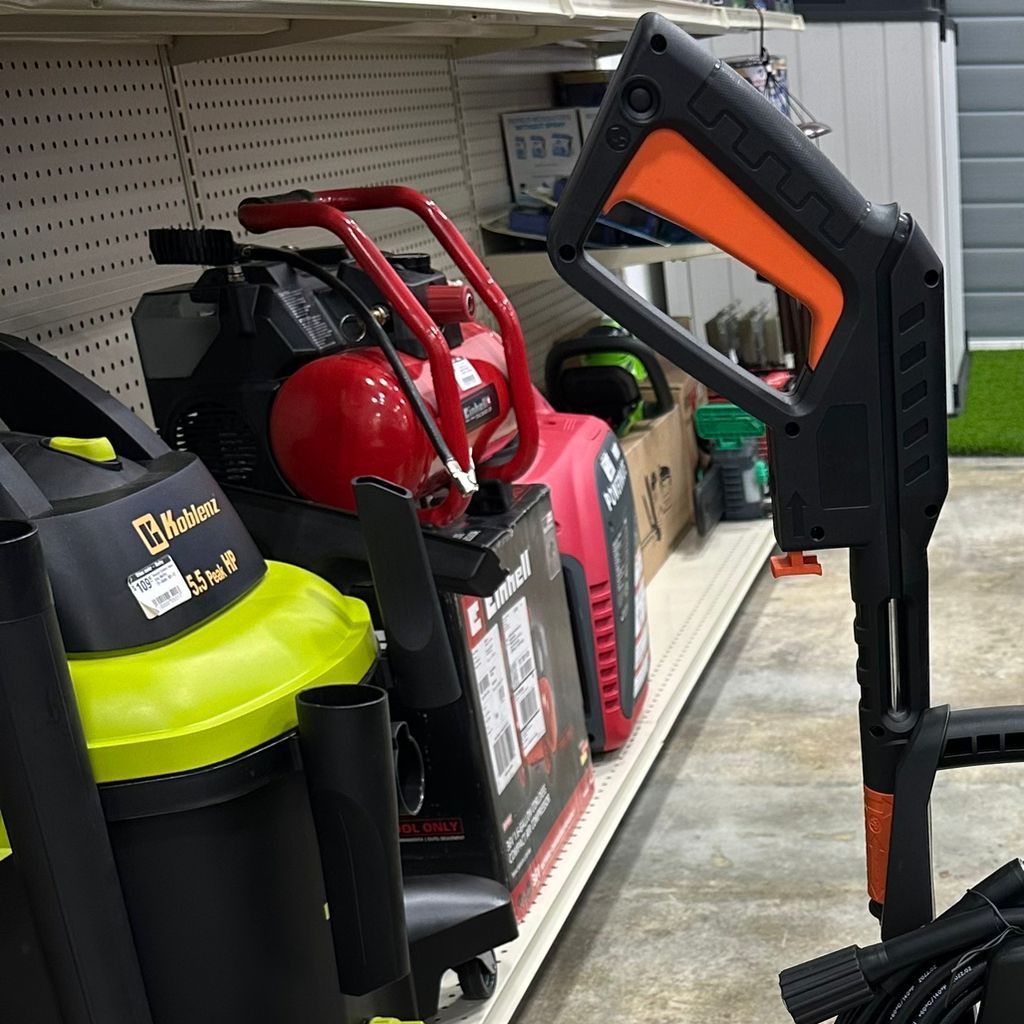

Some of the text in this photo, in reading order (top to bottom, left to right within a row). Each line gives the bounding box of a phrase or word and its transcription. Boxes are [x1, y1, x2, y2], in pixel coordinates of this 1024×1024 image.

[160, 498, 220, 540] Koblenz
[185, 569, 208, 596] 5.5
[204, 563, 228, 586] Peak
[220, 549, 239, 574] HP
[423, 822, 458, 833] ONLY
